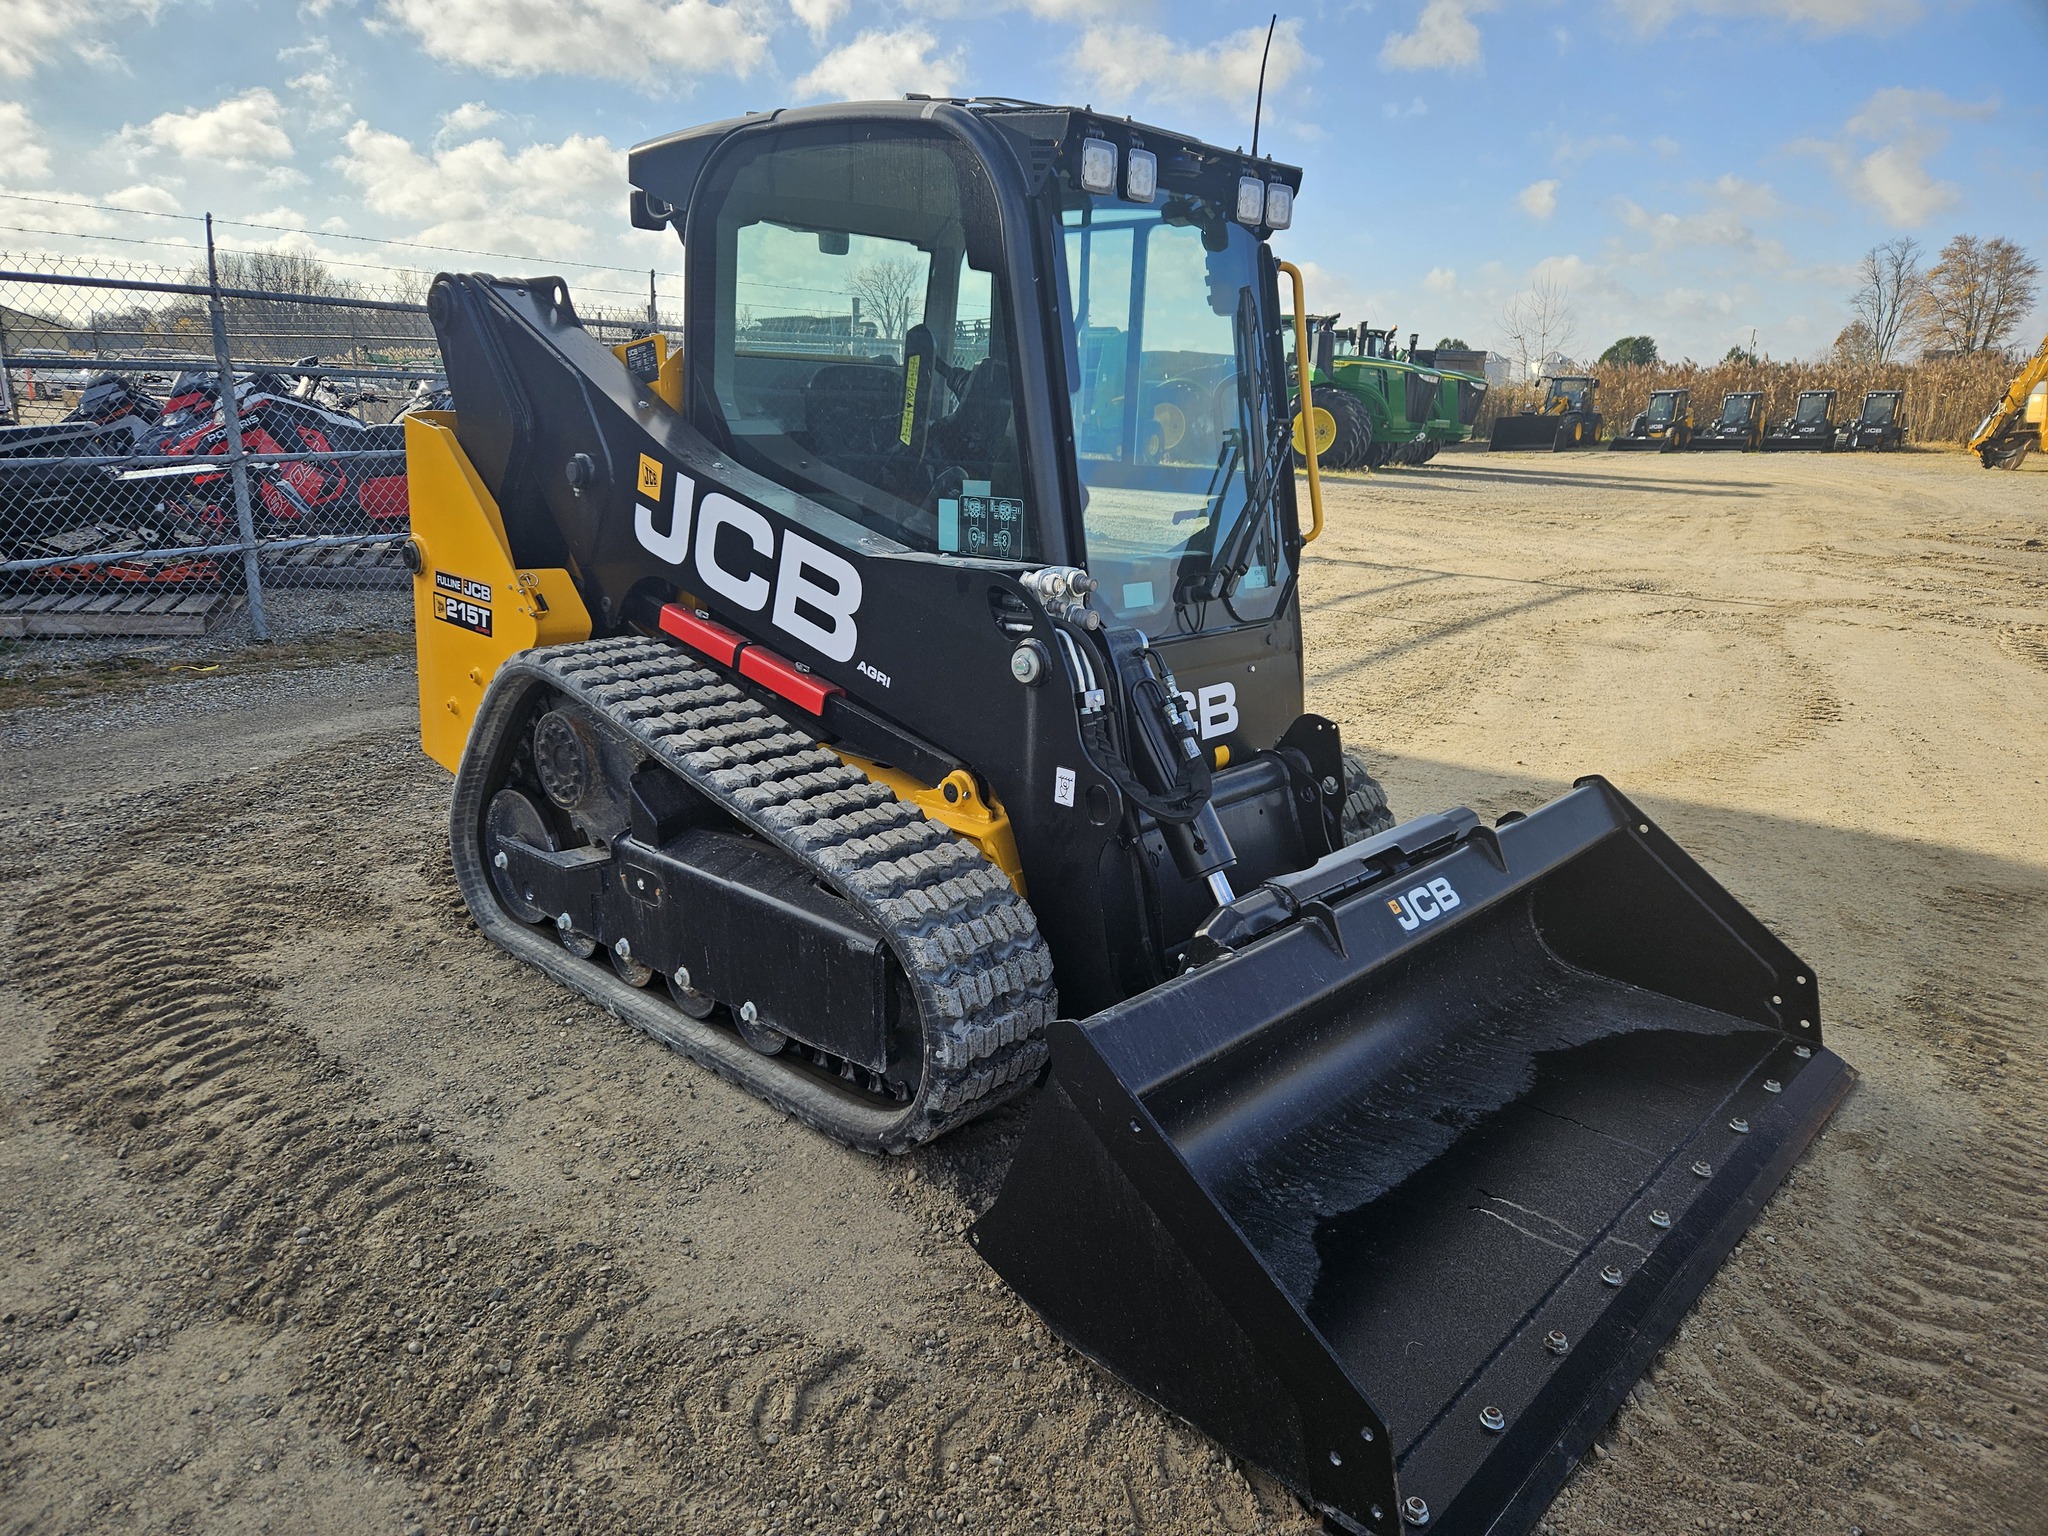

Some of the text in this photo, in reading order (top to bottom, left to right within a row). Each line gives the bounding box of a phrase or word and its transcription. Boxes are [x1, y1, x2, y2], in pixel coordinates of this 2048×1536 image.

[634, 471, 863, 663] JCB
[436, 574, 491, 601] FULLINE JCB
[446, 598, 491, 628] 215T
[856, 660, 891, 689] AGRI
[1398, 877, 1461, 931] JCB
